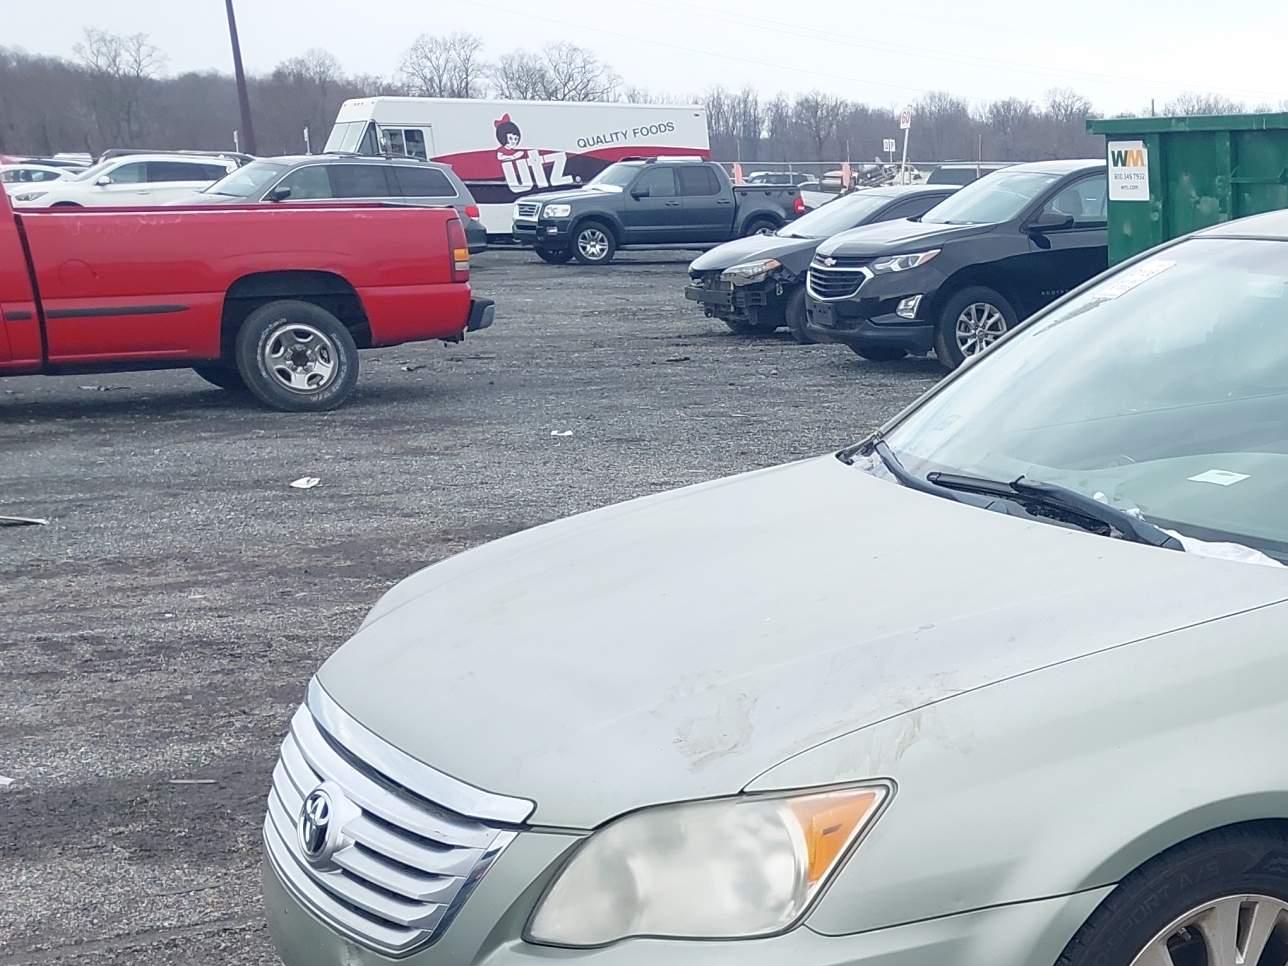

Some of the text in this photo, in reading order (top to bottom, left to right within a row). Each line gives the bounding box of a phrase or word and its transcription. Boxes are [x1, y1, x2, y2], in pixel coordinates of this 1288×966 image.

[577, 121, 675, 148] QUALITY FOODS
[1111, 150, 1145, 167] WM
